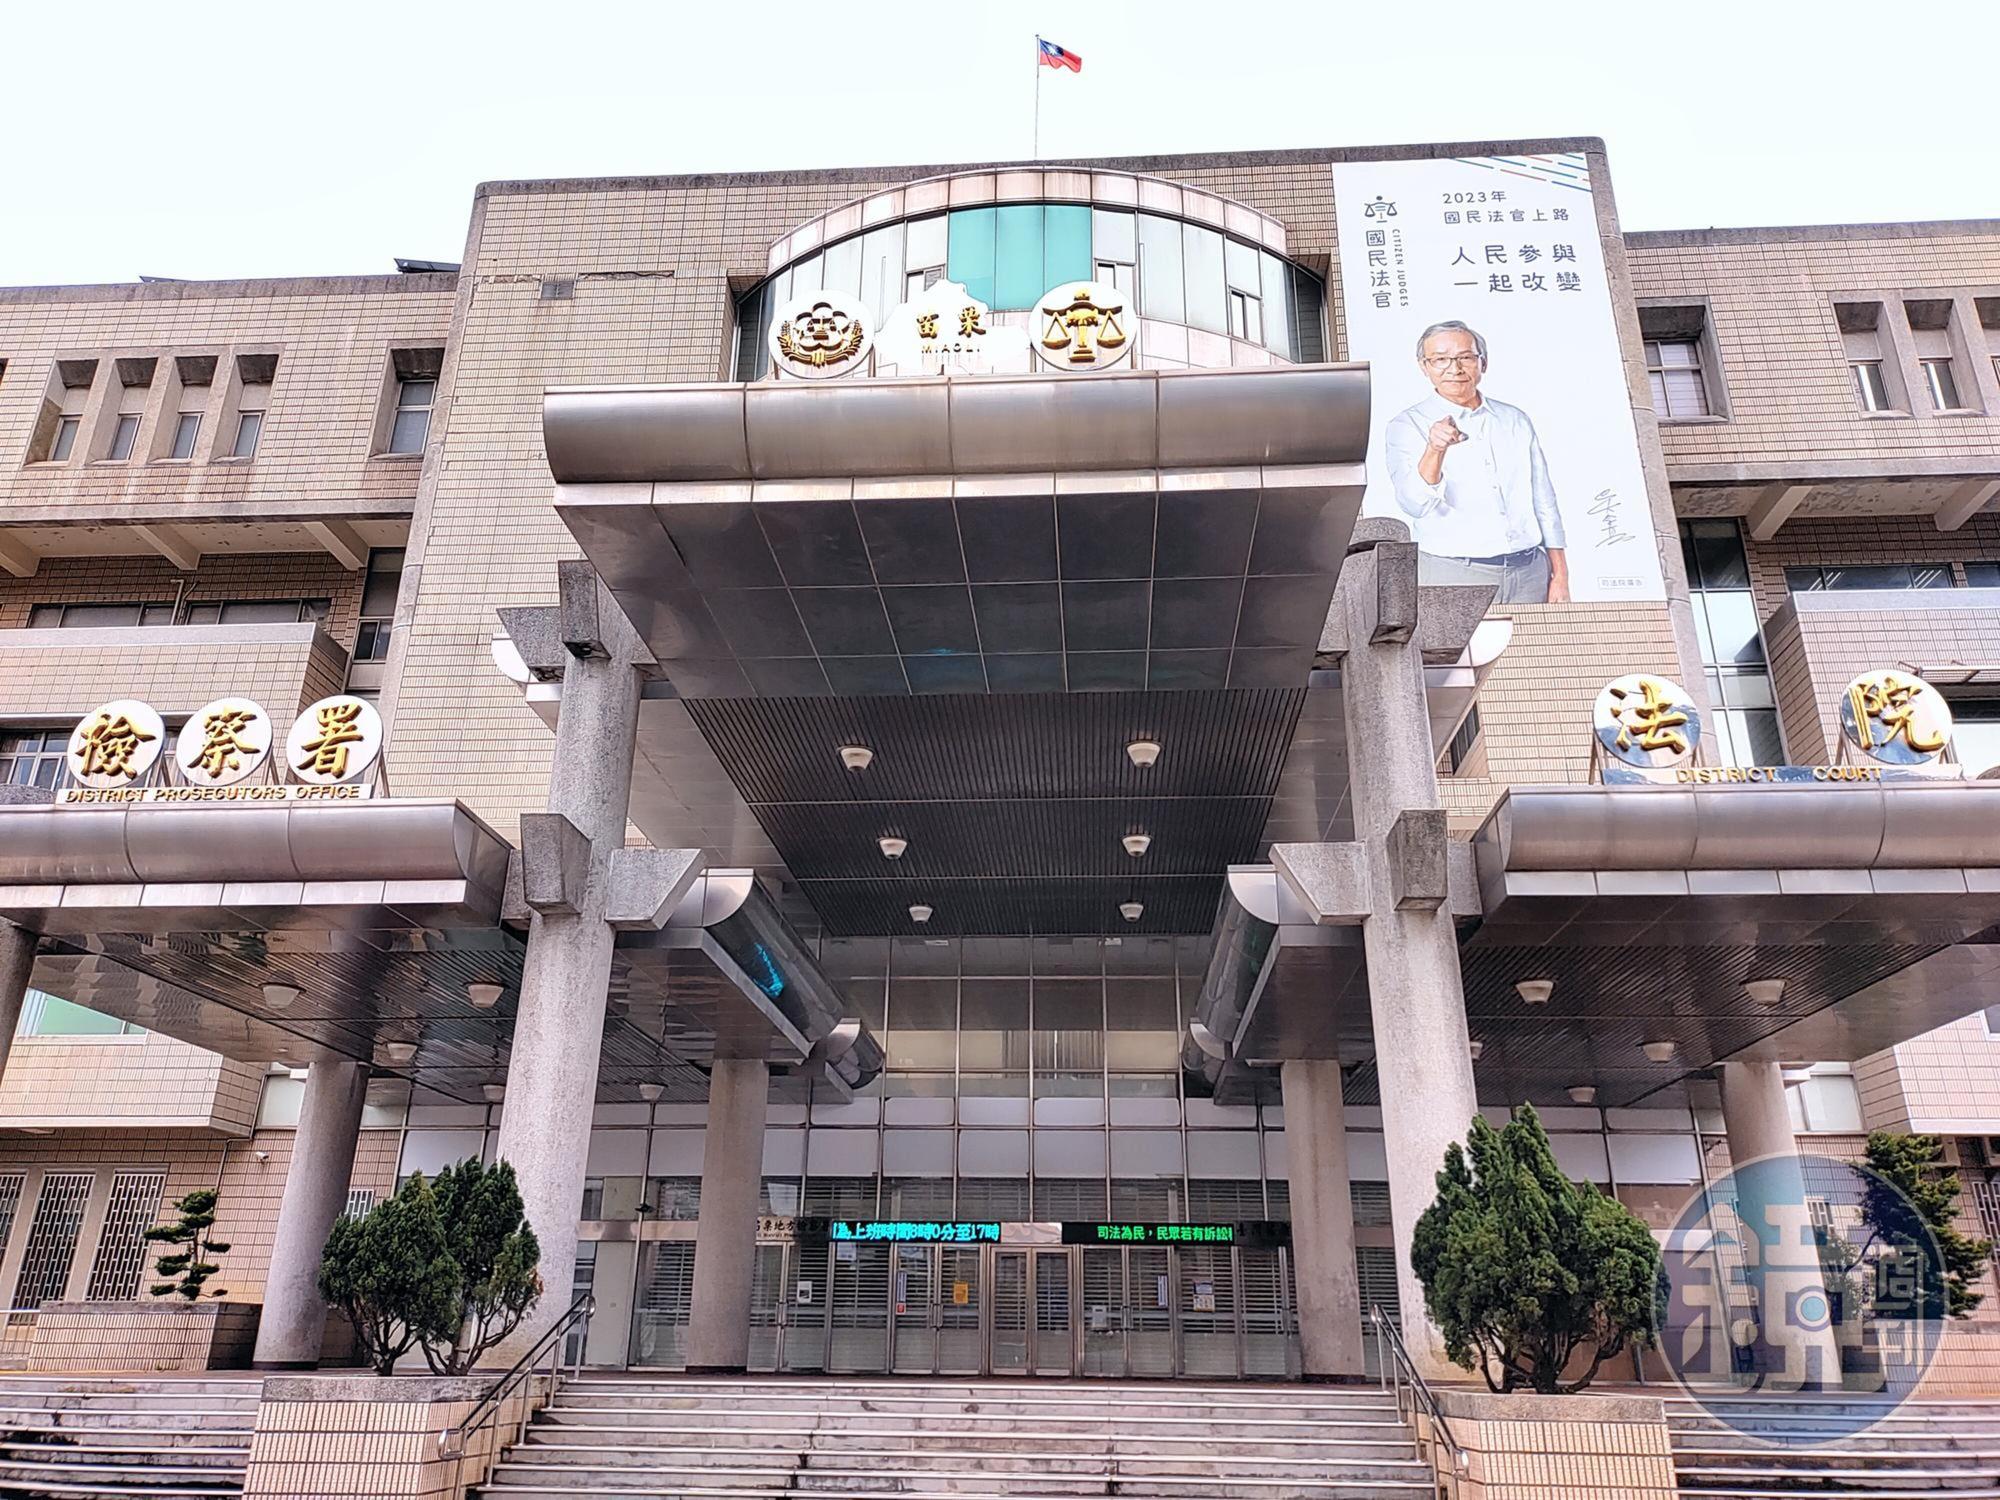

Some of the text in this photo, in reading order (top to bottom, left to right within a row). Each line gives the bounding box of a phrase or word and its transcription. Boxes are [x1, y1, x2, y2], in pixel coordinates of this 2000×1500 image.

[1442, 190, 1507, 204] 2023年
[1444, 208, 1569, 225] 國民法官上路
[1451, 243, 1577, 266] 人民參與
[1365, 229, 1392, 308] 國民法官
[1392, 228, 1409, 307] CITIZEN JUDGES
[1453, 271, 1582, 293] 一起改變
[916, 305, 987, 340] 苗栗
[74, 703, 364, 781] 檢察署
[1675, 766, 1883, 784] DISTRICT COURT
[65, 785, 361, 803] DISTRICT PROSECUTORS OFFICE
